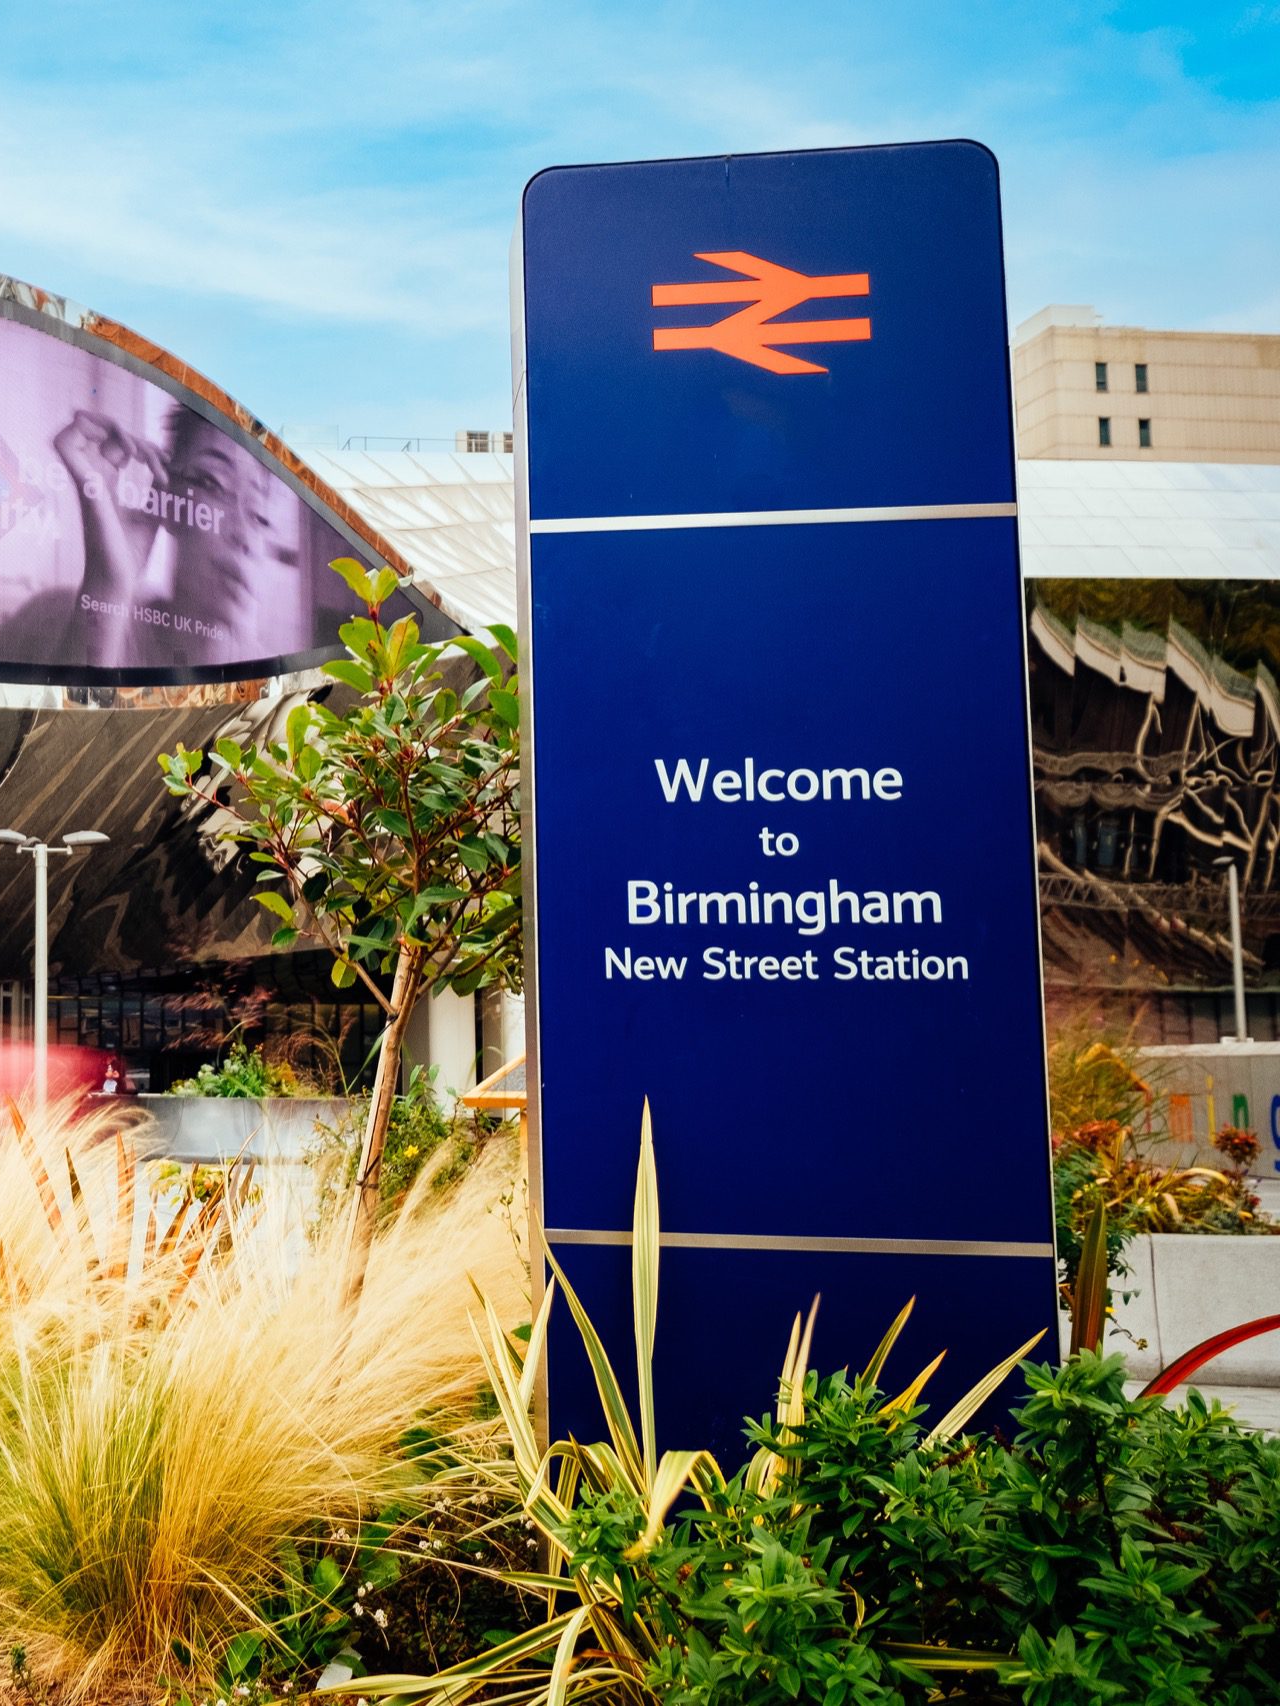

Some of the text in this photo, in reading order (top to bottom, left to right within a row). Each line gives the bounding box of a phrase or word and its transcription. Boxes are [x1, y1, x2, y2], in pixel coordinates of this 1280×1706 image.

[83, 471, 104, 499] a
[119, 472, 224, 534] barrier
[81, 594, 224, 641] Search HSBC UK Pride
[655, 757, 903, 803] Welcome
[758, 826, 800, 857] to
[627, 879, 943, 935] Birmingham
[604, 946, 970, 980] New Street Station
